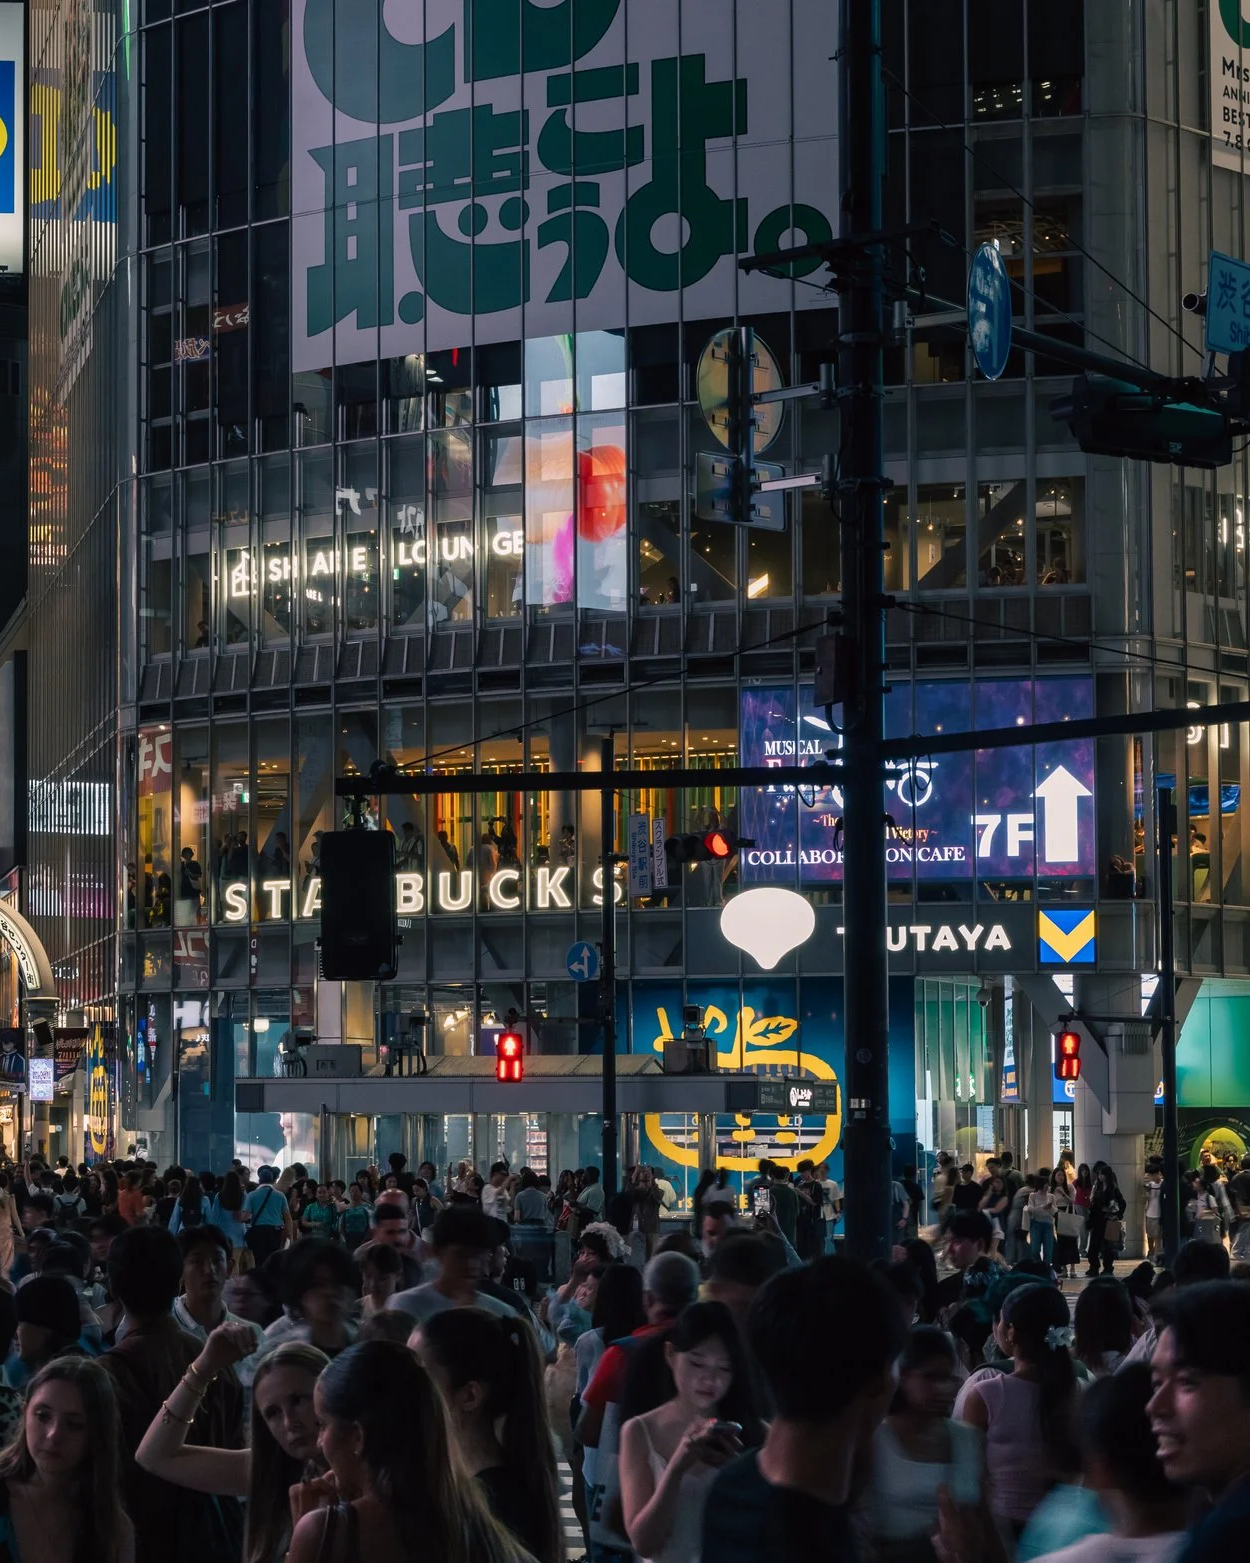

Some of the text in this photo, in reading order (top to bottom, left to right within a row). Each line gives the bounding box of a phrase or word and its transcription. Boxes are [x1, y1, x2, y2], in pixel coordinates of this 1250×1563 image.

[764, 739, 822, 757] MUSICAL
[971, 813, 1034, 858] 7F
[225, 866, 623, 920] STABUCKS
[836, 924, 1012, 952] UTAYA
